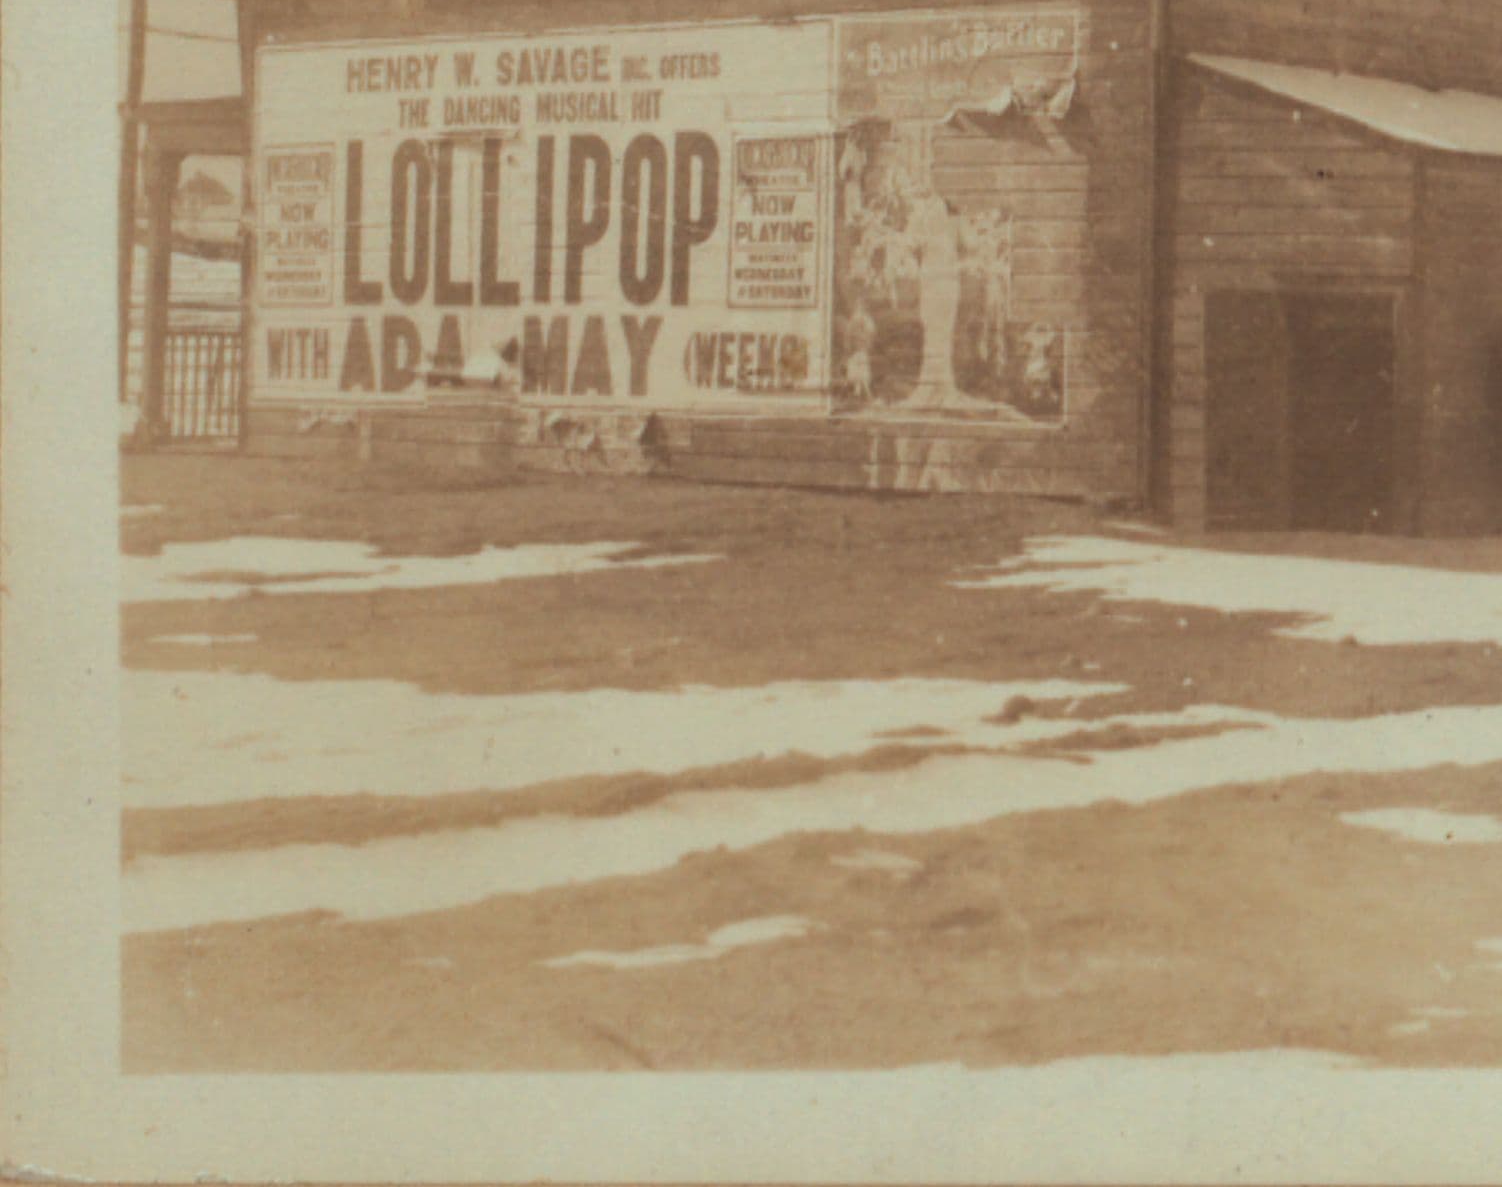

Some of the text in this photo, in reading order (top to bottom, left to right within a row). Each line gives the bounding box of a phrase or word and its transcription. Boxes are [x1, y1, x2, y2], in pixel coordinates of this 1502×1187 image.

[347, 52, 440, 93] HENRY
[454, 52, 480, 87] W.
[496, 44, 612, 87] SAVAGE
[660, 51, 722, 80] OFFERS
[398, 88, 664, 128] THE DANCING MUSICAL HIT
[343, 131, 721, 308] LOLLIPOP
[752, 195, 797, 217] NOW
[735, 221, 815, 244] PLAYING
[267, 327, 331, 381] WITH
[338, 315, 467, 394] ADA
[520, 315, 666, 397] MAY
